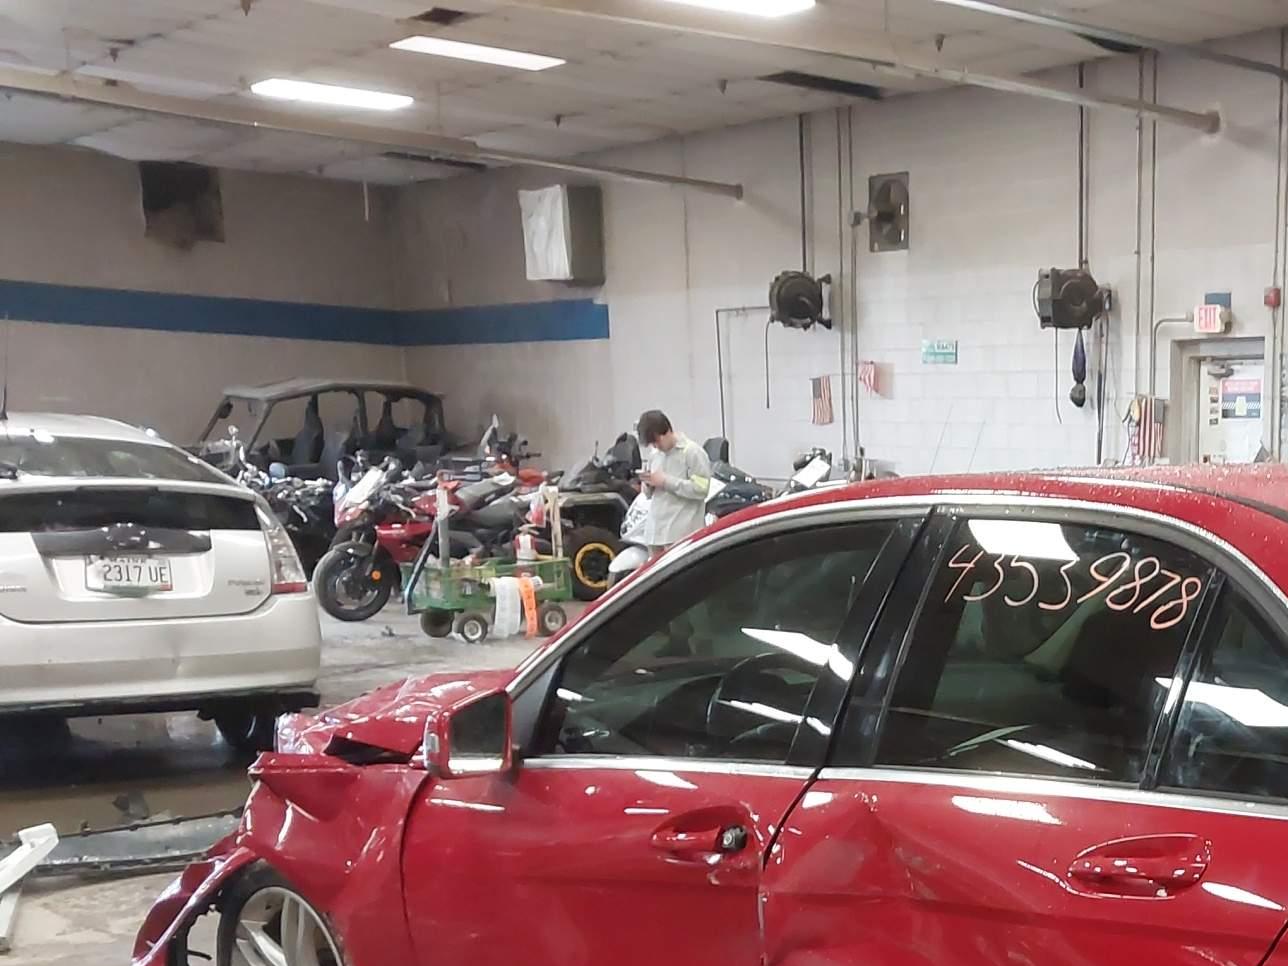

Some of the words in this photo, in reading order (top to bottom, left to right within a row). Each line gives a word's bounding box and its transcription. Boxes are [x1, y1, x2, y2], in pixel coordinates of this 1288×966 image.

[1199, 307, 1217, 329] EXIT
[103, 564, 142, 583] 2317
[148, 566, 169, 583] UE
[945, 544, 1202, 630] 43539878
